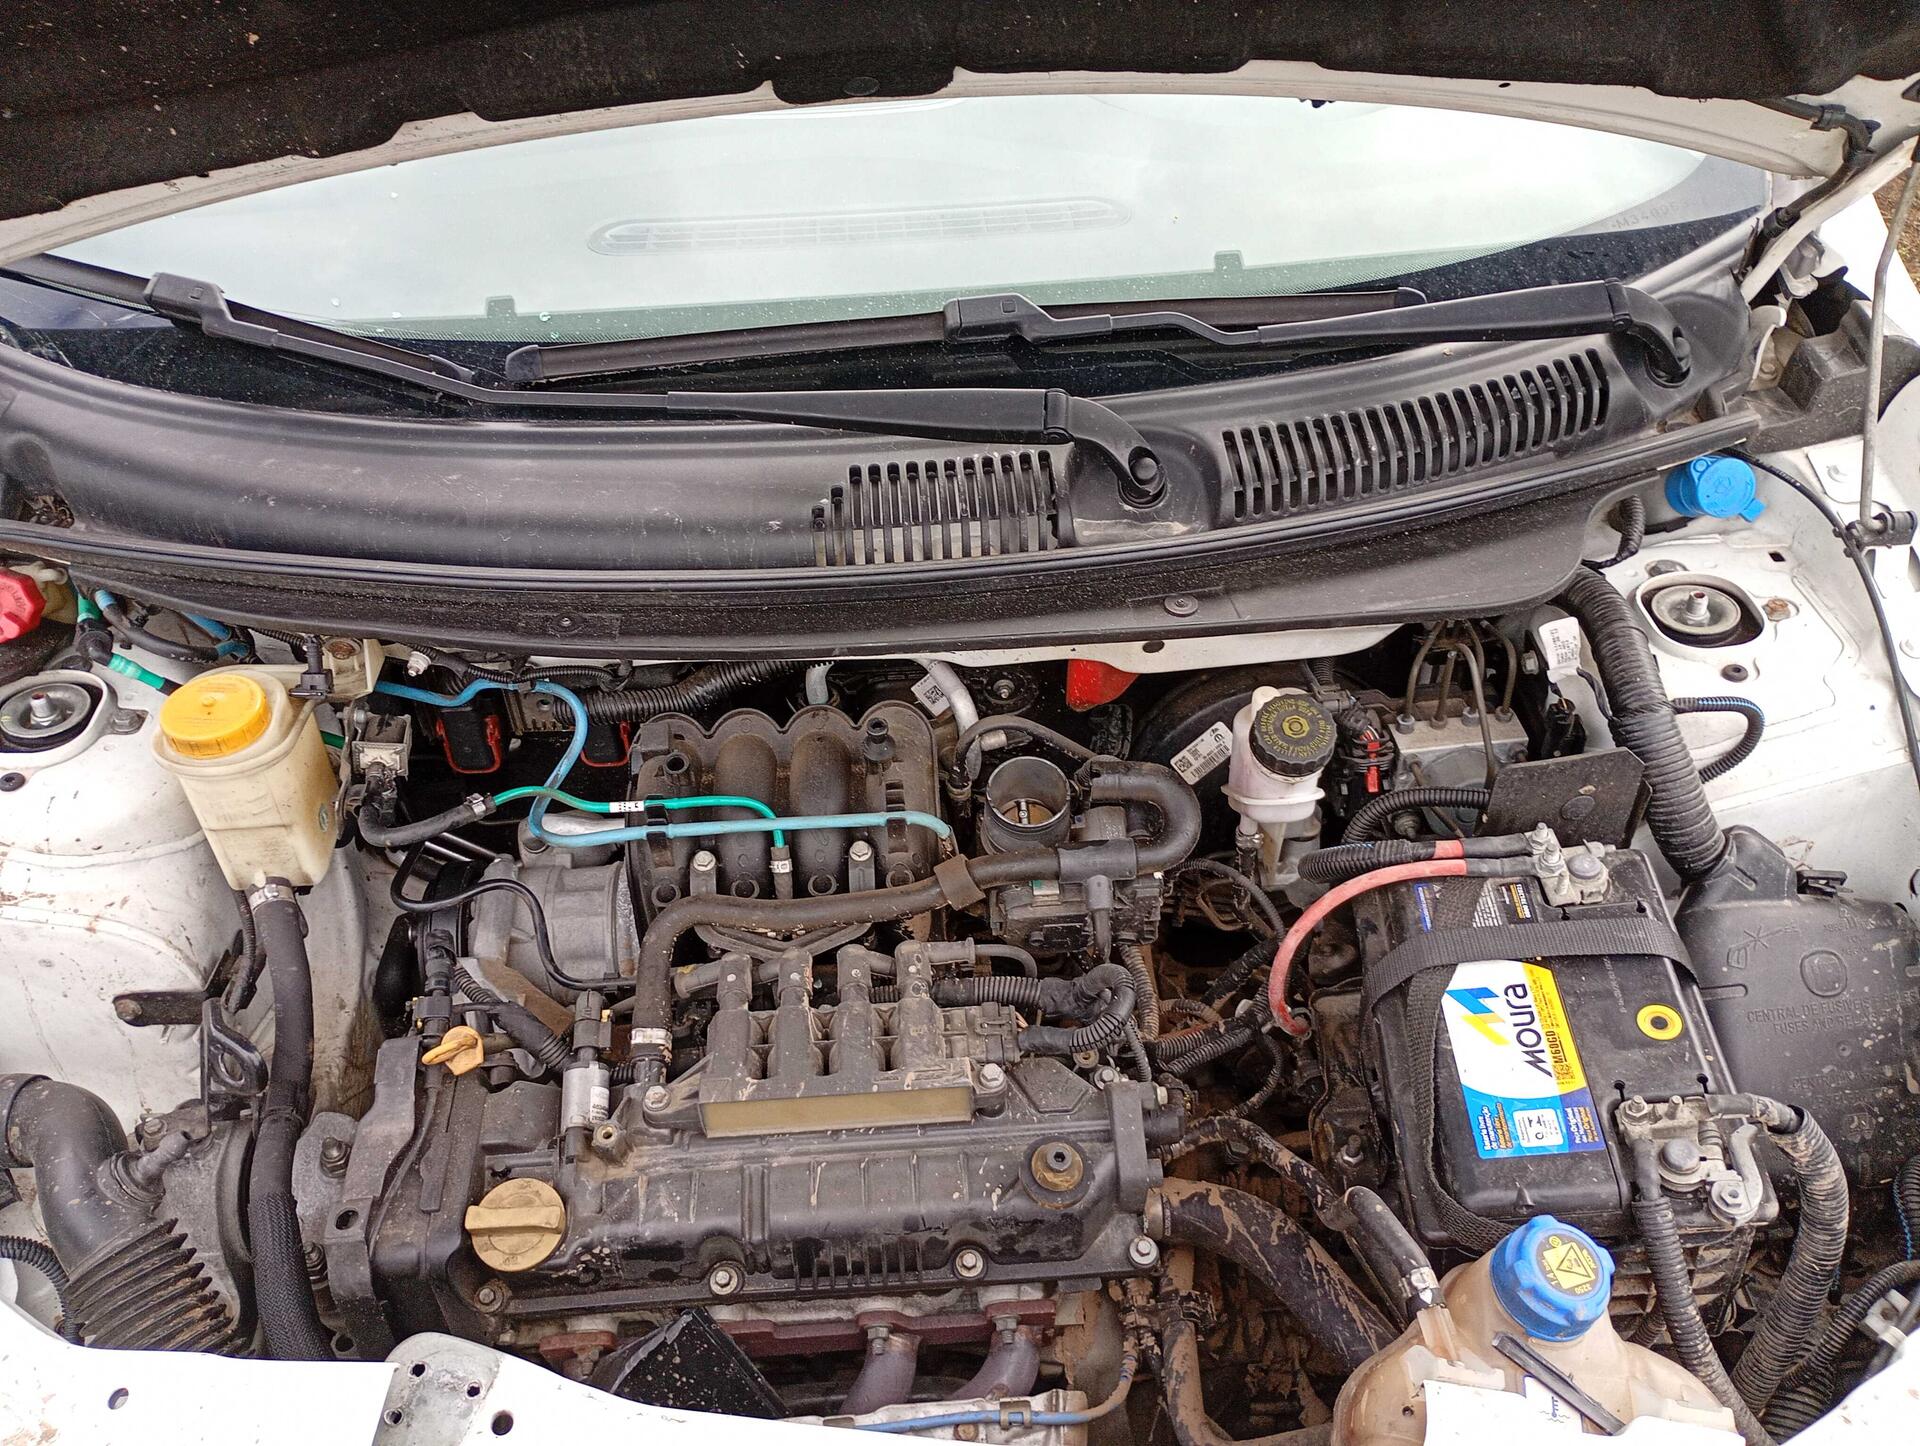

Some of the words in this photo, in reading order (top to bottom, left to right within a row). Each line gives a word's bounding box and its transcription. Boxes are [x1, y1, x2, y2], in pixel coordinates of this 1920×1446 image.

[1746, 1007, 1801, 1024] CENTRAL
[1801, 1003, 1818, 1015] DE
[1773, 1021, 1809, 1035] FUSES
